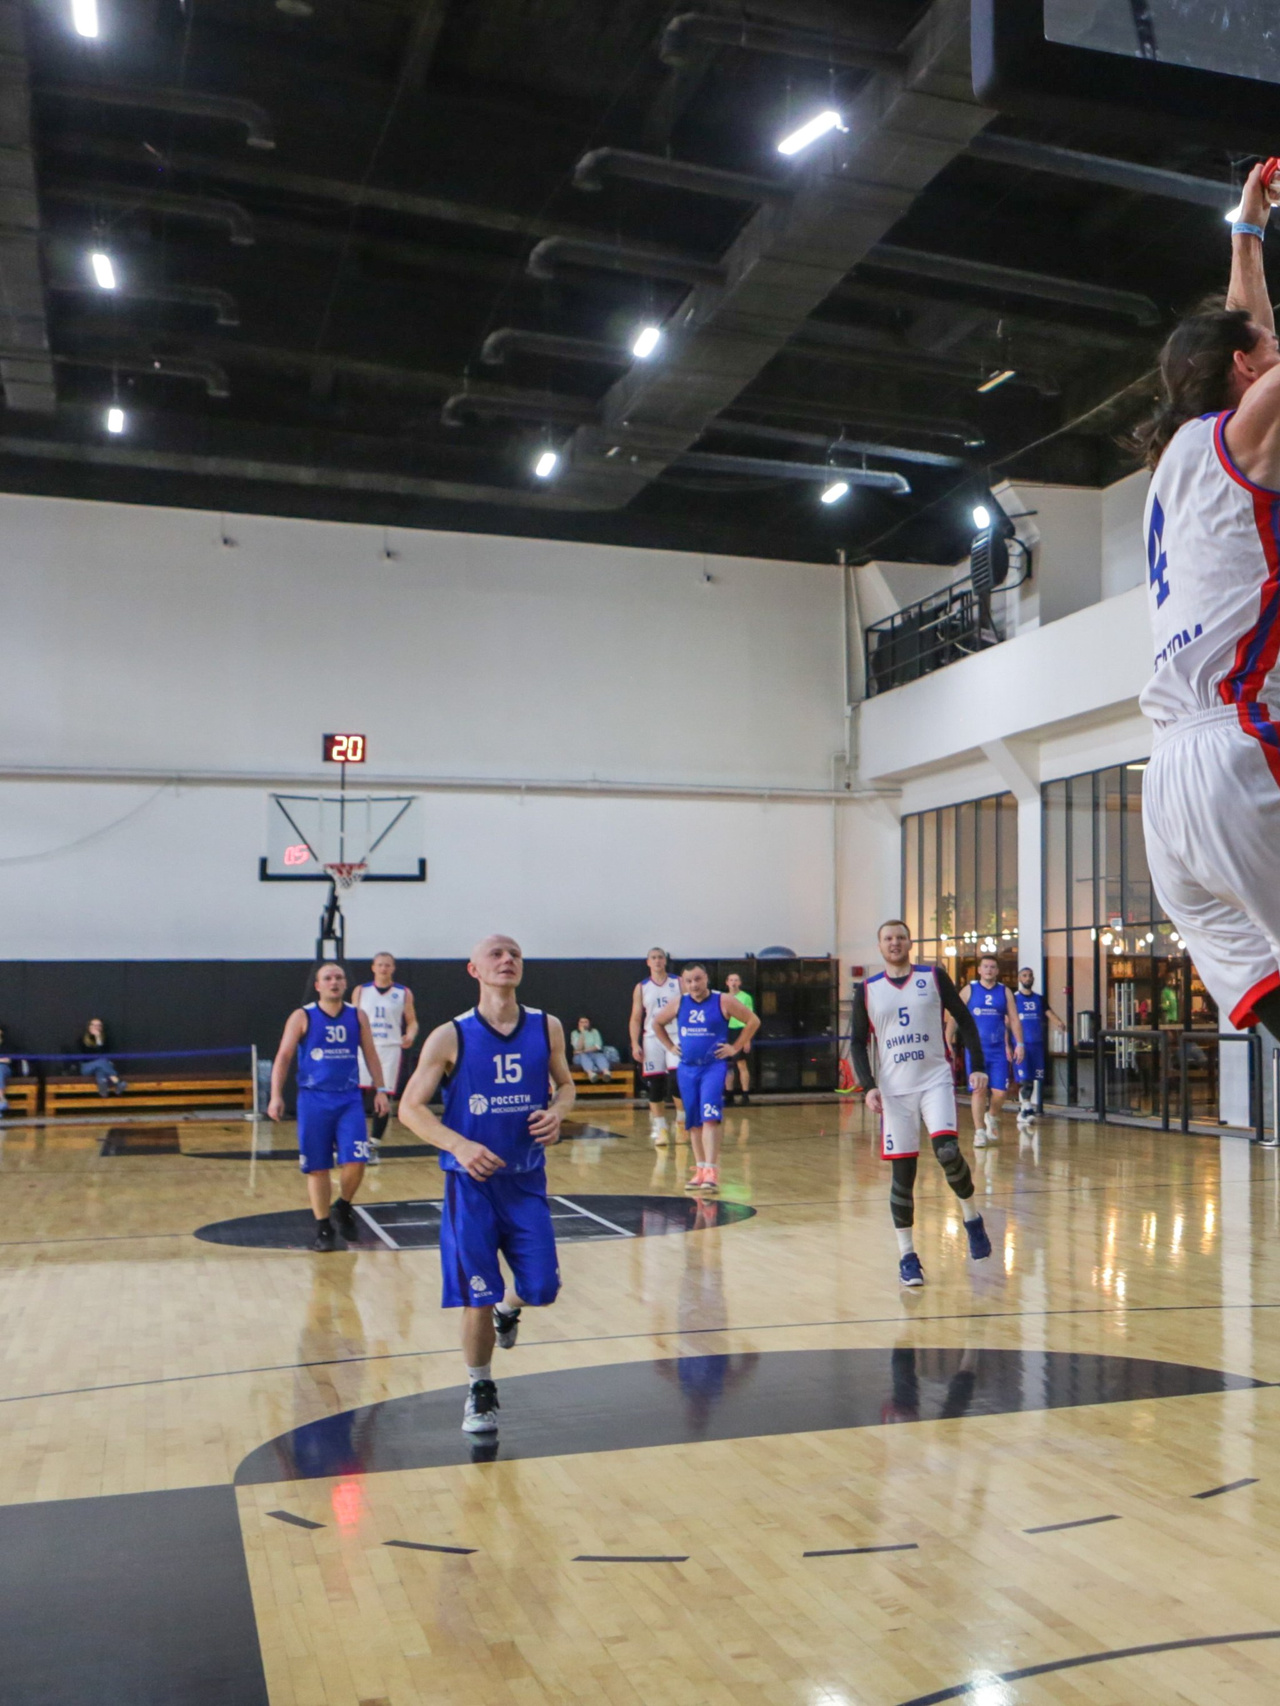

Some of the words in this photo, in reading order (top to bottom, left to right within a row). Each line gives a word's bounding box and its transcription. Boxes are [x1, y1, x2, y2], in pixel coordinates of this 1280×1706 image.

[1148, 492, 1170, 610] 4
[332, 736, 363, 761] 20
[984, 994, 993, 1005] 2
[1023, 1001, 1036, 1011] 33
[688, 1009, 706, 1024] 24
[898, 1006, 910, 1026] 5
[325, 1024, 347, 1043] 30
[886, 1033, 929, 1049] ВНИИЭФ
[893, 1050, 925, 1063] САРОВ
[493, 1053, 523, 1084] 15
[490, 1094, 531, 1105] РОССЕТИ
[703, 1103, 719, 1117] 24
[886, 1134, 894, 1151] 5
